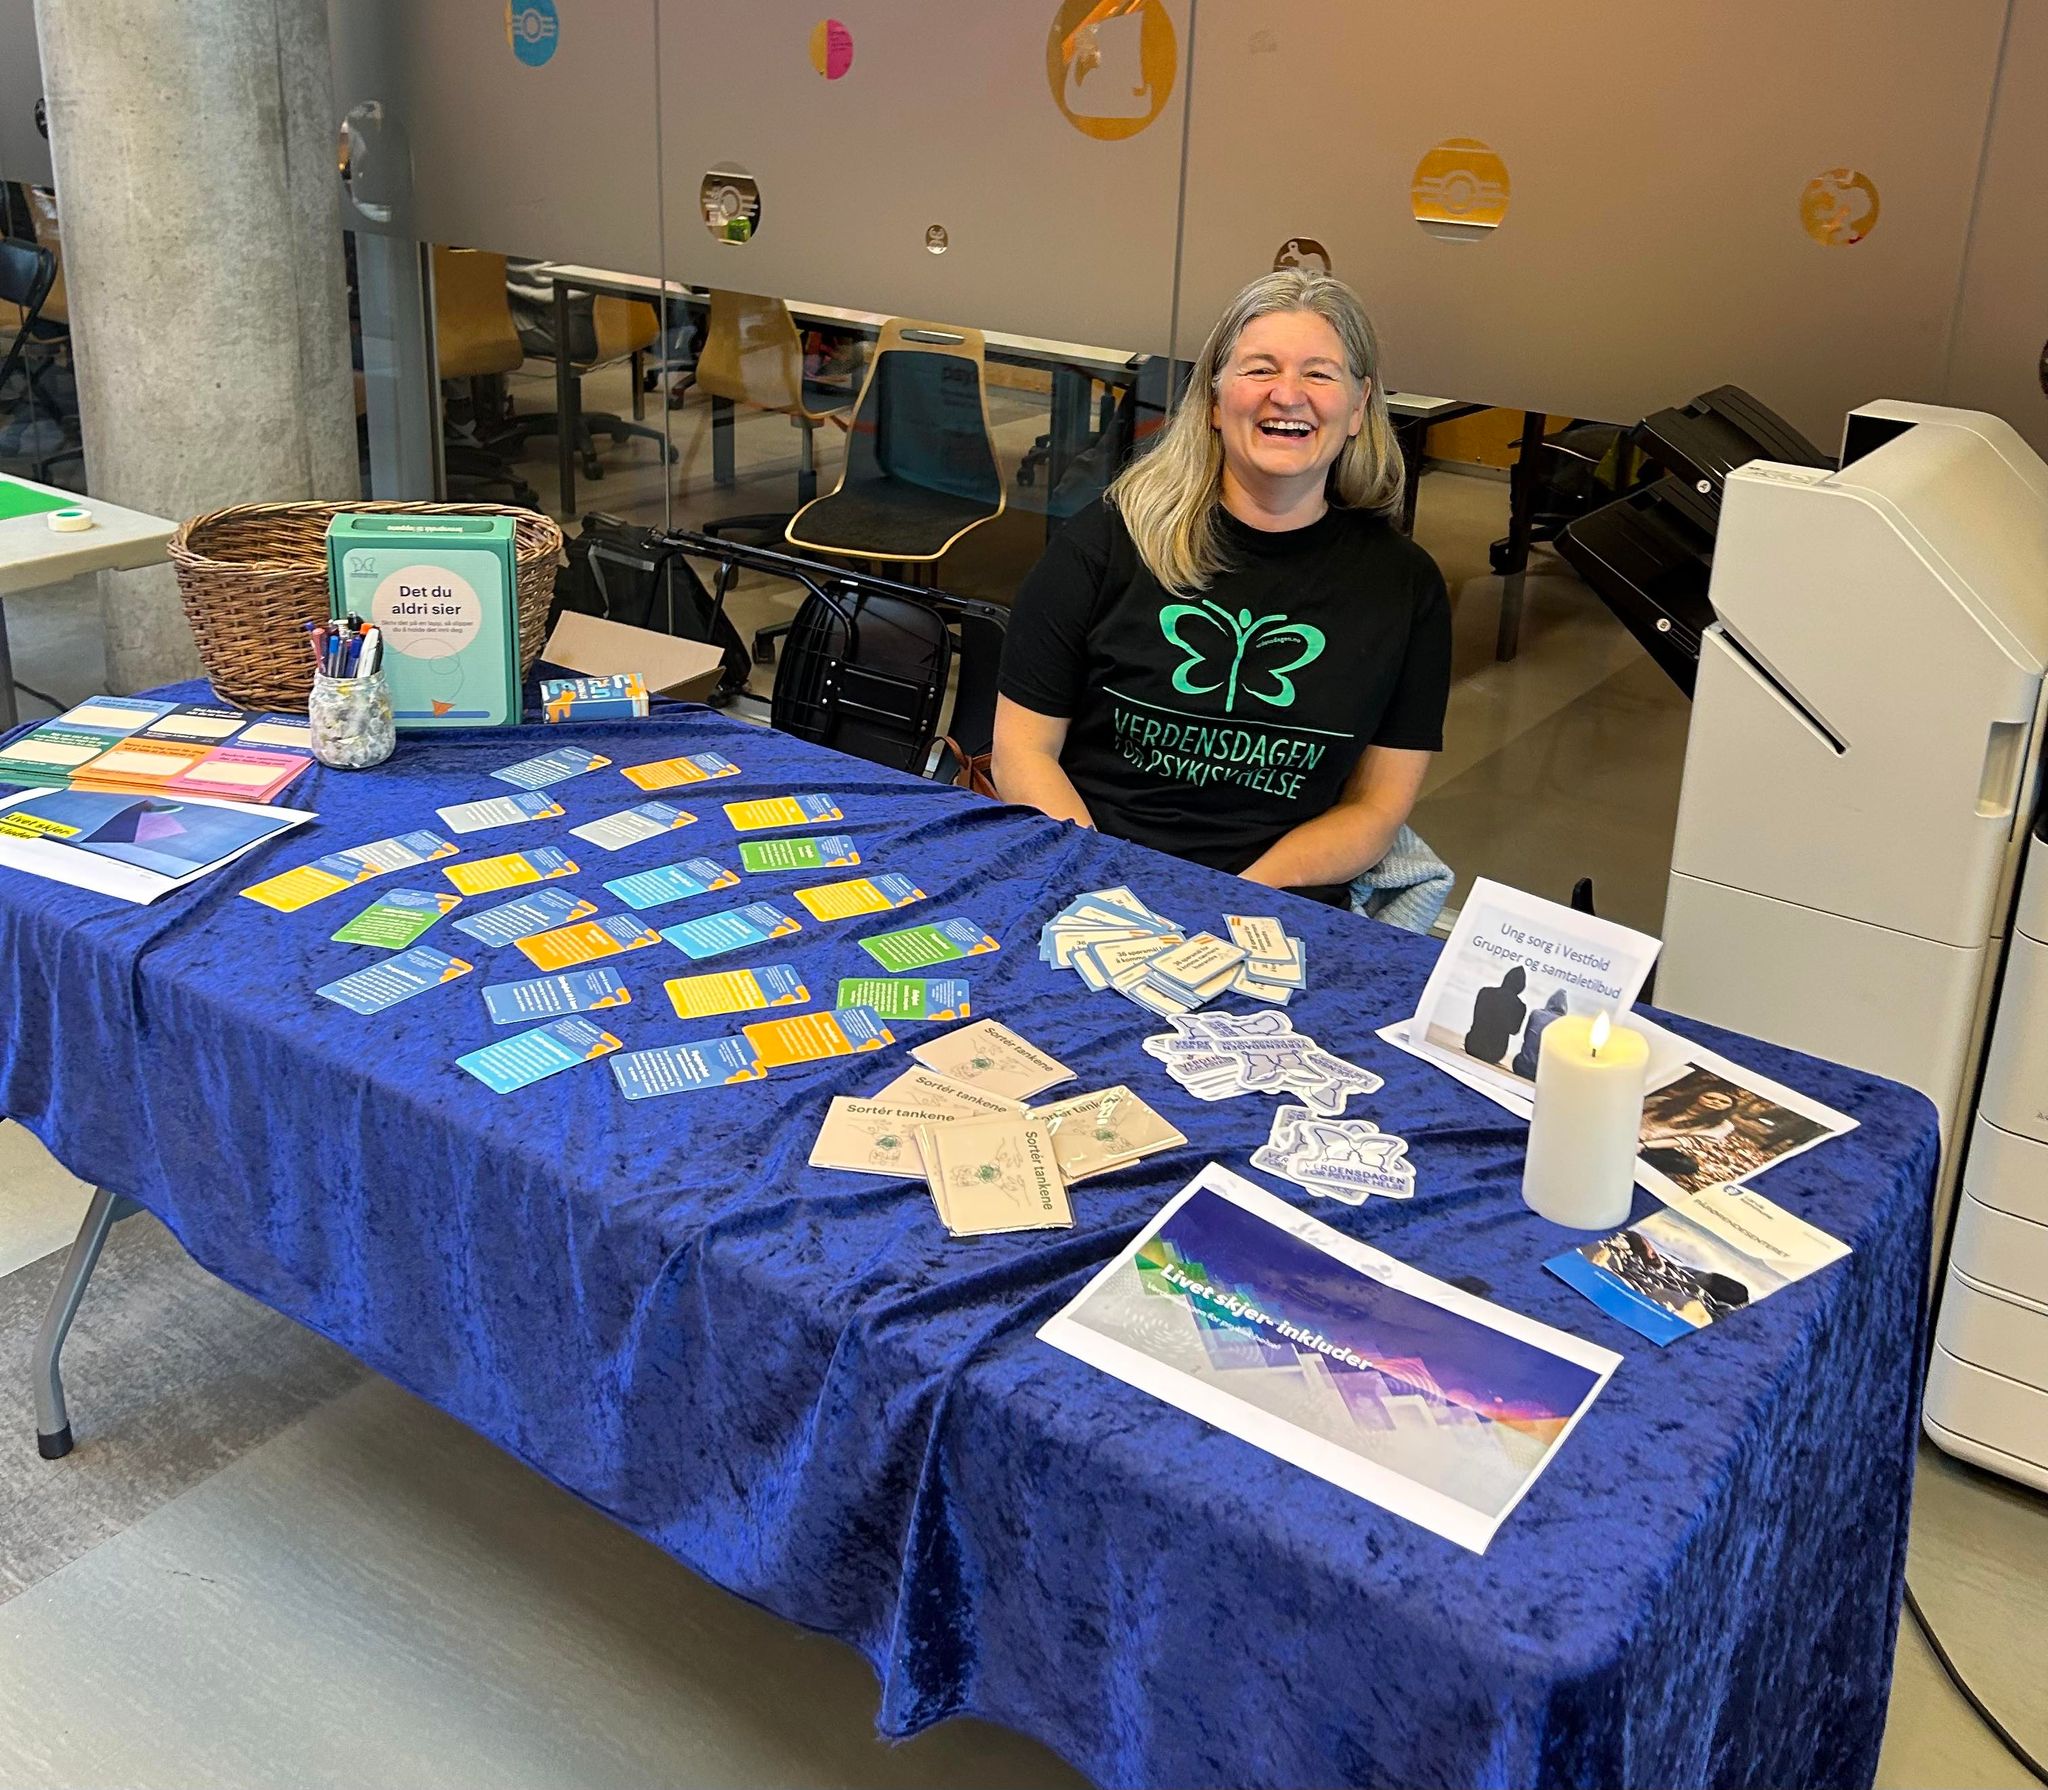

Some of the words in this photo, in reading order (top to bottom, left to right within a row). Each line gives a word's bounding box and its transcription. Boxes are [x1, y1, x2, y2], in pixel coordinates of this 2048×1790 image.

[392, 603, 428, 614] aldri
[432, 603, 462, 615] sier
[400, 586, 428, 598] Det
[431, 586, 452, 598] du
[1114, 708, 1326, 770] VERDENSDAGEN
[1472, 935, 1523, 964] Grupper
[1524, 956, 1540, 972] og
[1541, 962, 1622, 1000] samtaletilbud
[1500, 922, 1526, 944] Ung
[1528, 934, 1553, 955] sorg
[1554, 942, 1562, 954] i
[1562, 944, 1612, 972] Vestfold
[984, 1026, 1016, 1050] Sortér
[1014, 1045, 1054, 1072] tankene
[847, 1104, 892, 1116] Sortér
[896, 1108, 955, 1122] tankene
[915, 1076, 954, 1094] Sortér
[956, 1089, 1008, 1113] tankene
[1026, 1130, 1042, 1166] Sortér
[1032, 1163, 1053, 1210] tankene
[1160, 1263, 1216, 1300] Livet
[1213, 1293, 1275, 1327] skjer-
[1276, 1320, 1373, 1372] inkluder
